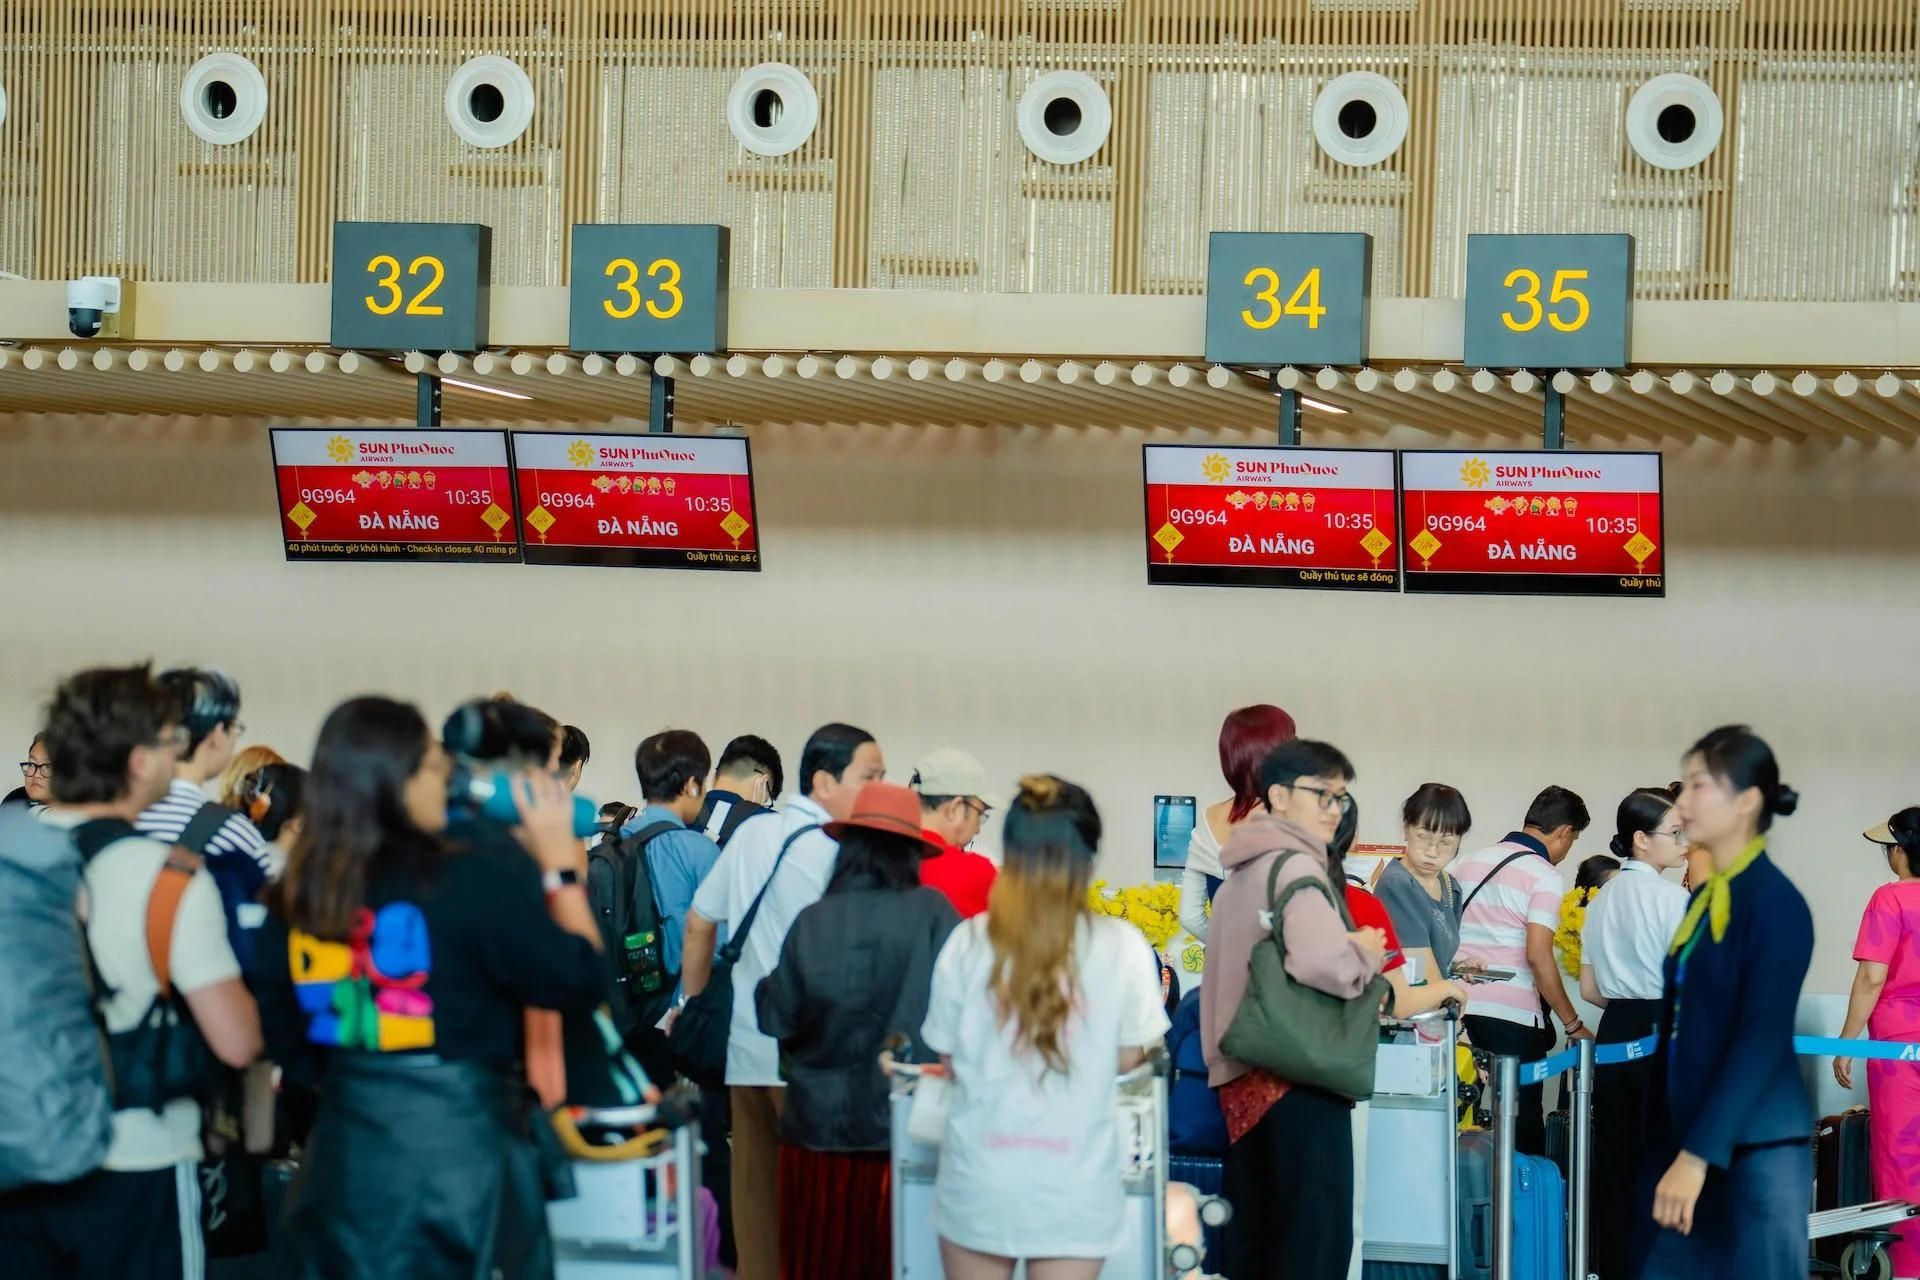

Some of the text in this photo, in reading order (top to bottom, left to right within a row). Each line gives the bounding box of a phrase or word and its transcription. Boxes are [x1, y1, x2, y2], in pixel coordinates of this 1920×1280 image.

[365, 255, 444, 315] 32
[603, 258, 684, 319] 33
[1241, 267, 1327, 330] 34
[1501, 268, 1591, 332] 35
[359, 443, 388, 453] SUN
[600, 448, 628, 459] SUN
[1236, 462, 1267, 473] SUN
[1496, 466, 1527, 477] SUN
[301, 489, 356, 504] 9G964
[445, 490, 491, 505] 10:35
[541, 492, 595, 508] 9G964
[685, 497, 731, 512] 10:35
[359, 512, 385, 529] ĐÀ
[1170, 509, 1228, 526] 9G964
[1323, 513, 1373, 529] 10:35
[1427, 515, 1486, 532] 9G964
[1586, 517, 1637, 534] 10:35
[597, 517, 623, 535] ĐÀ
[301, 544, 320, 553] phút
[322, 544, 344, 552] trước
[346, 544, 359, 553] giờ
[380, 544, 401, 552] hành
[407, 545, 442, 553] Check-in
[445, 545, 472, 553] closes
[473, 545, 484, 553] 40
[486, 546, 507, 554] mins
[1229, 534, 1256, 553] ĐÀ
[1488, 540, 1515, 560] ĐÀ
[726, 554, 738, 563] tục
[1300, 570, 1393, 583] Quầy thủ tục sẽ đóng
[1620, 577, 1661, 588] Quầy thủ
